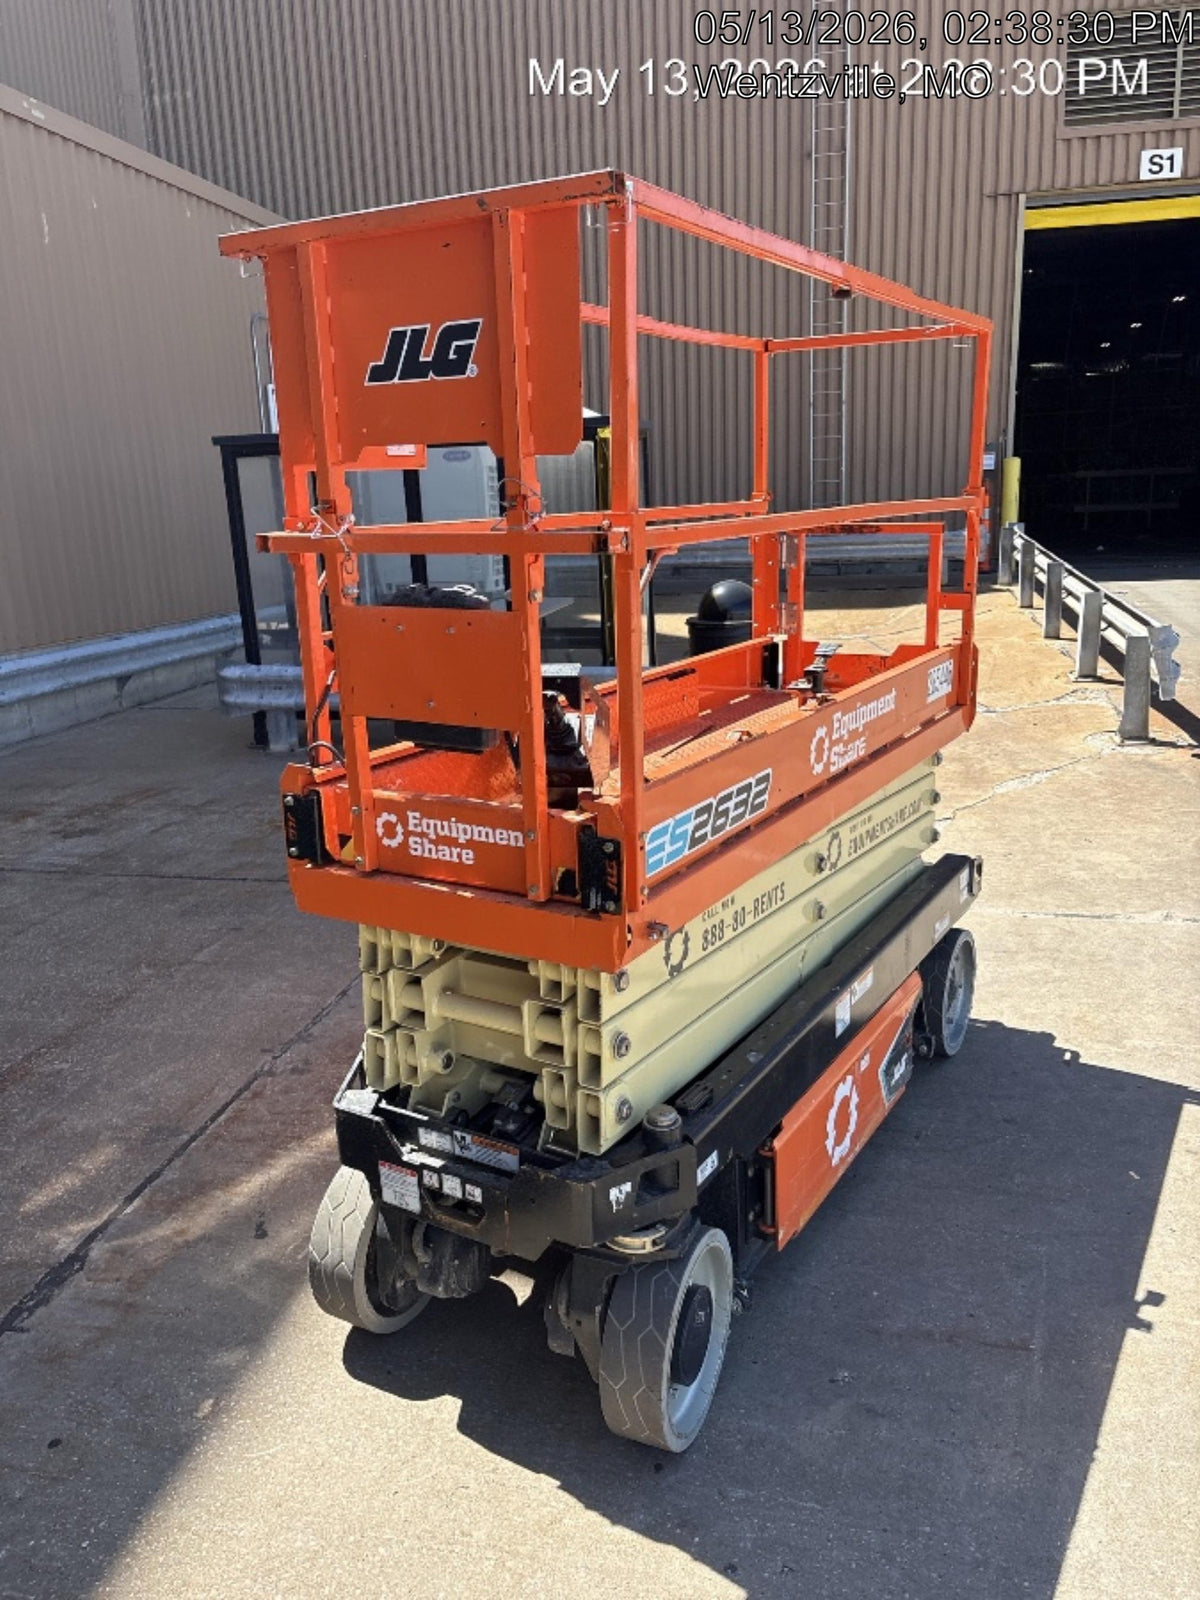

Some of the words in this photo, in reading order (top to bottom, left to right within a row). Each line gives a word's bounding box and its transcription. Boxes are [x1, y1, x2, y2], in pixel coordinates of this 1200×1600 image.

[1147, 153, 1176, 176] S1
[831, 687, 898, 740] Equipment
[829, 736, 867, 774] Share
[406, 810, 525, 848] Equipmen
[645, 767, 773, 879] ES2632
[408, 836, 475, 865] Share
[701, 881, 786, 952] 888-80-RENTS
